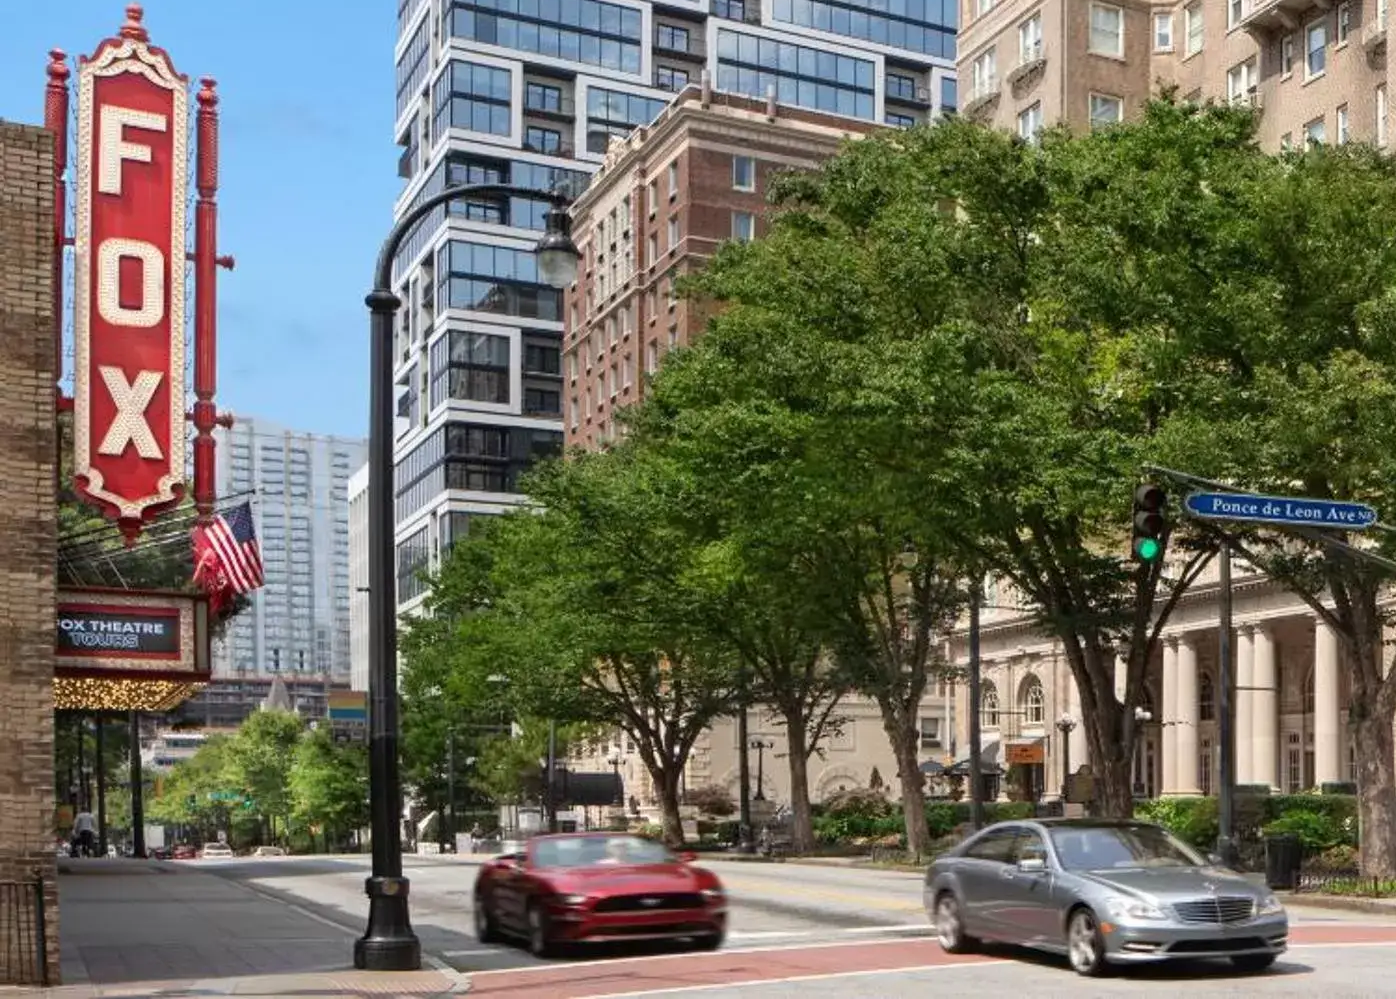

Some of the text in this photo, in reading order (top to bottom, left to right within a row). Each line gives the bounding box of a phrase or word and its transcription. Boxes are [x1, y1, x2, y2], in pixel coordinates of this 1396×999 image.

[98, 103, 167, 461] FOX
[1212, 498, 1258, 515] Ponce
[1262, 502, 1281, 516] de
[1286, 503, 1322, 520] Leon
[1327, 508, 1358, 522] Ave
[90, 620, 164, 634] THEATRE
[70, 632, 138, 647] TOURS
